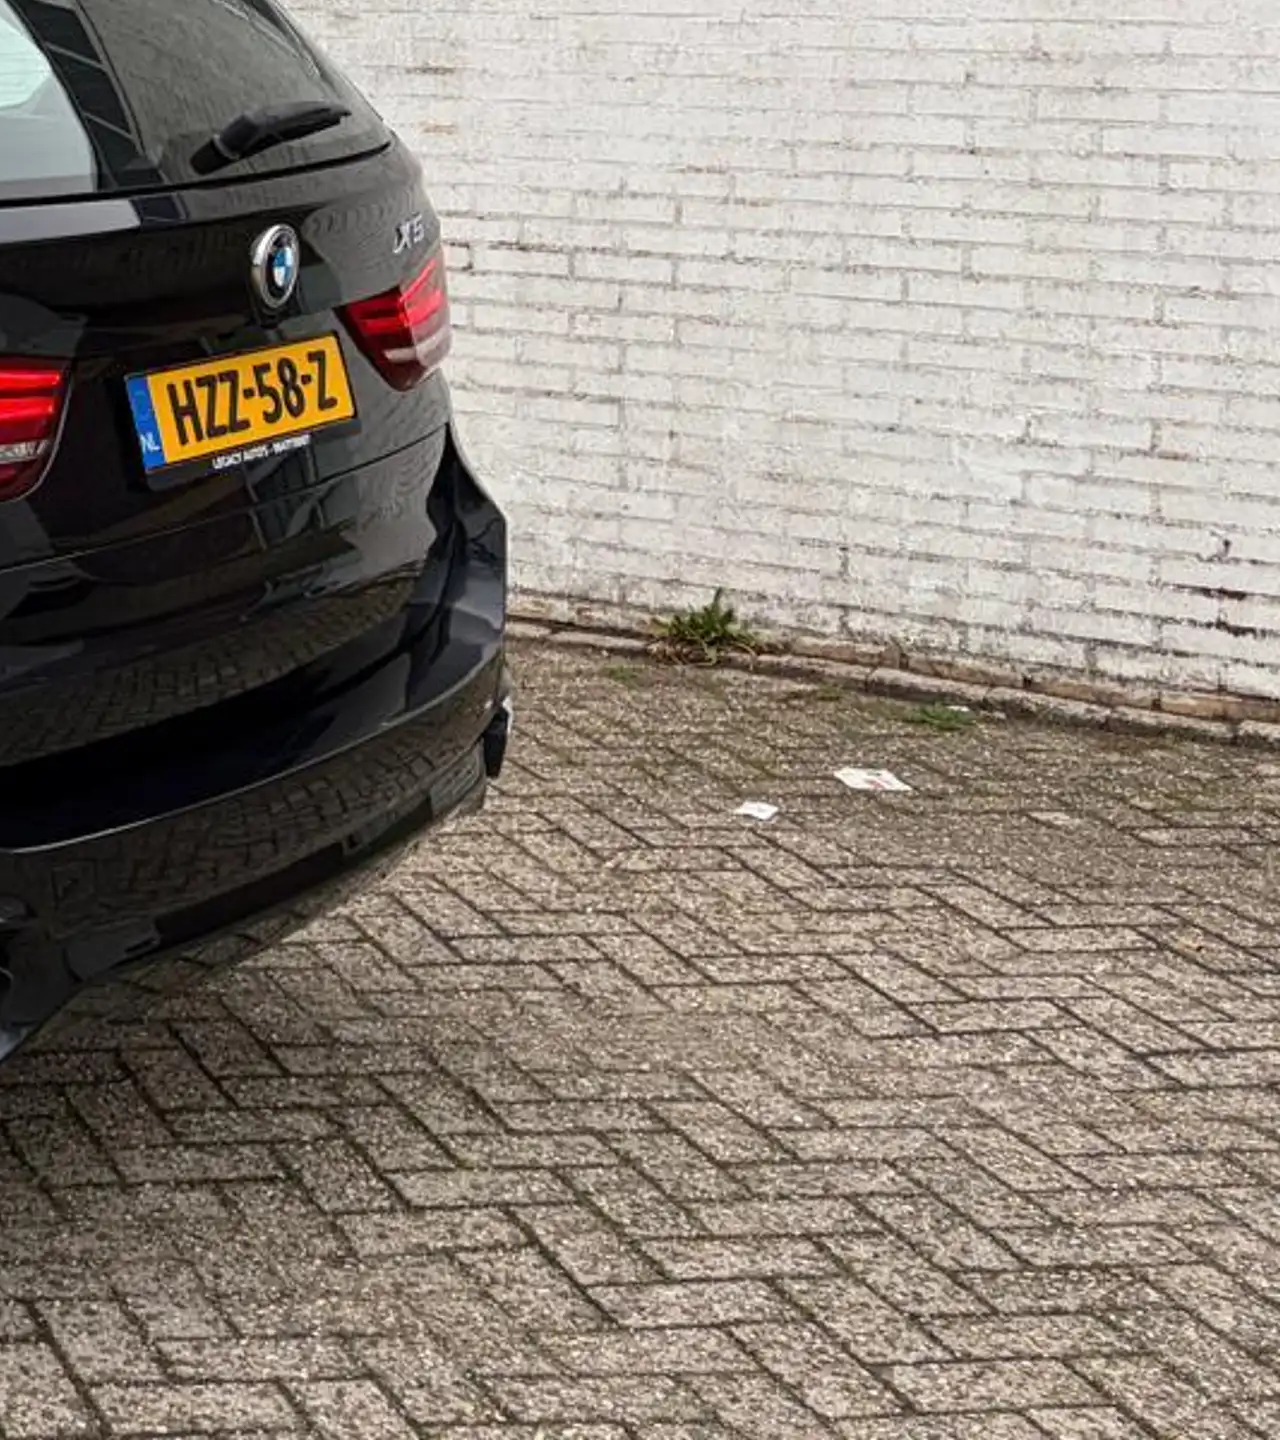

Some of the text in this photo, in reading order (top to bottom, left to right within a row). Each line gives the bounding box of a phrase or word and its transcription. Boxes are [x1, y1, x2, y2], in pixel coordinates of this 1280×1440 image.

[392, 212, 425, 254] X5
[166, 350, 338, 445] HZZ-58-Z
[140, 433, 160, 453] NL
